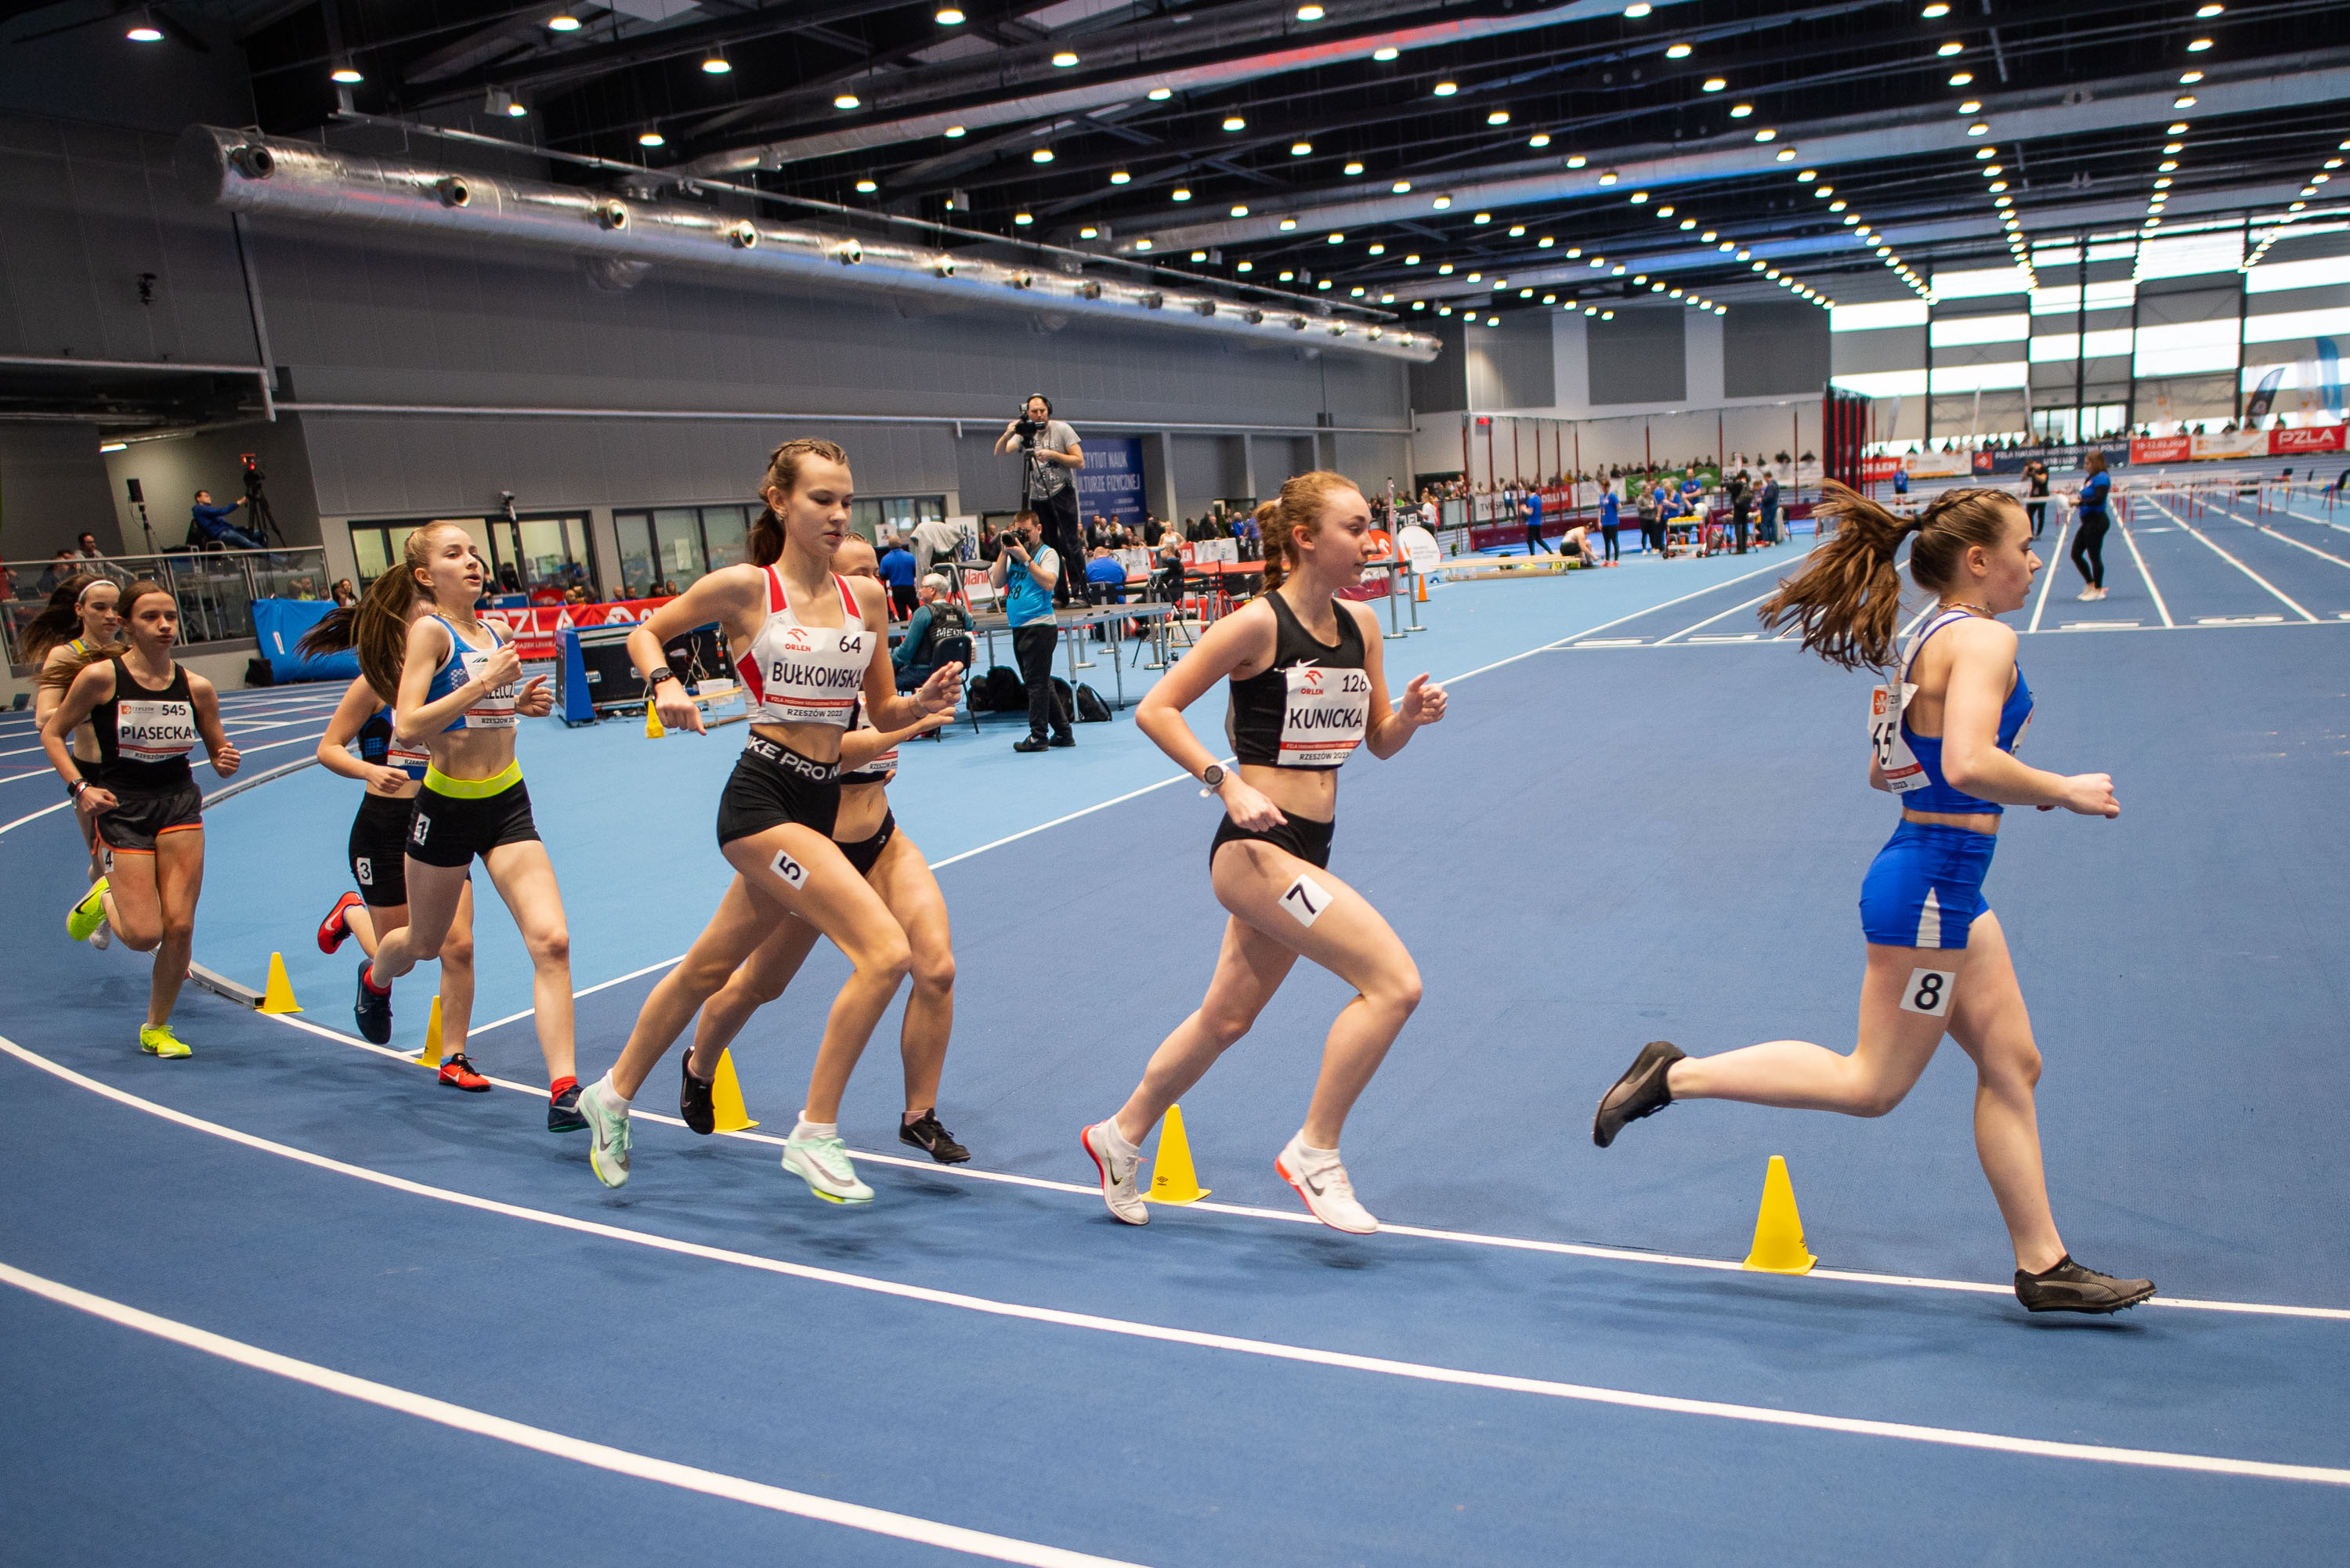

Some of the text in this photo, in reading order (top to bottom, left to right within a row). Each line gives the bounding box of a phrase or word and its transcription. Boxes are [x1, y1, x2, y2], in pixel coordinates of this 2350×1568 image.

[2278, 430, 2334, 445] PZLA
[1108, 450, 1128, 468] NAUK
[1077, 475, 1105, 493] ULTURZE
[1106, 473, 1141, 492] FIZYCZNEJ
[785, 643, 812, 652] ORLEN
[839, 635, 861, 653] 64
[772, 661, 861, 688] BUŁKOWSKA
[1342, 674, 1367, 692] 126
[162, 704, 186, 716] 545
[787, 708, 826, 717] RZESZÓW
[1289, 708, 1363, 729] KUNICKA
[121, 726, 192, 740] PIASECKA
[1299, 751, 1332, 761] RZESZÓW
[779, 752, 826, 780] PRO
[418, 821, 427, 840] 1
[105, 850, 113, 868] 4
[779, 855, 801, 880] 5
[360, 862, 371, 880] 3
[1285, 882, 1317, 915] 7
[1914, 972, 1943, 1010] 8
